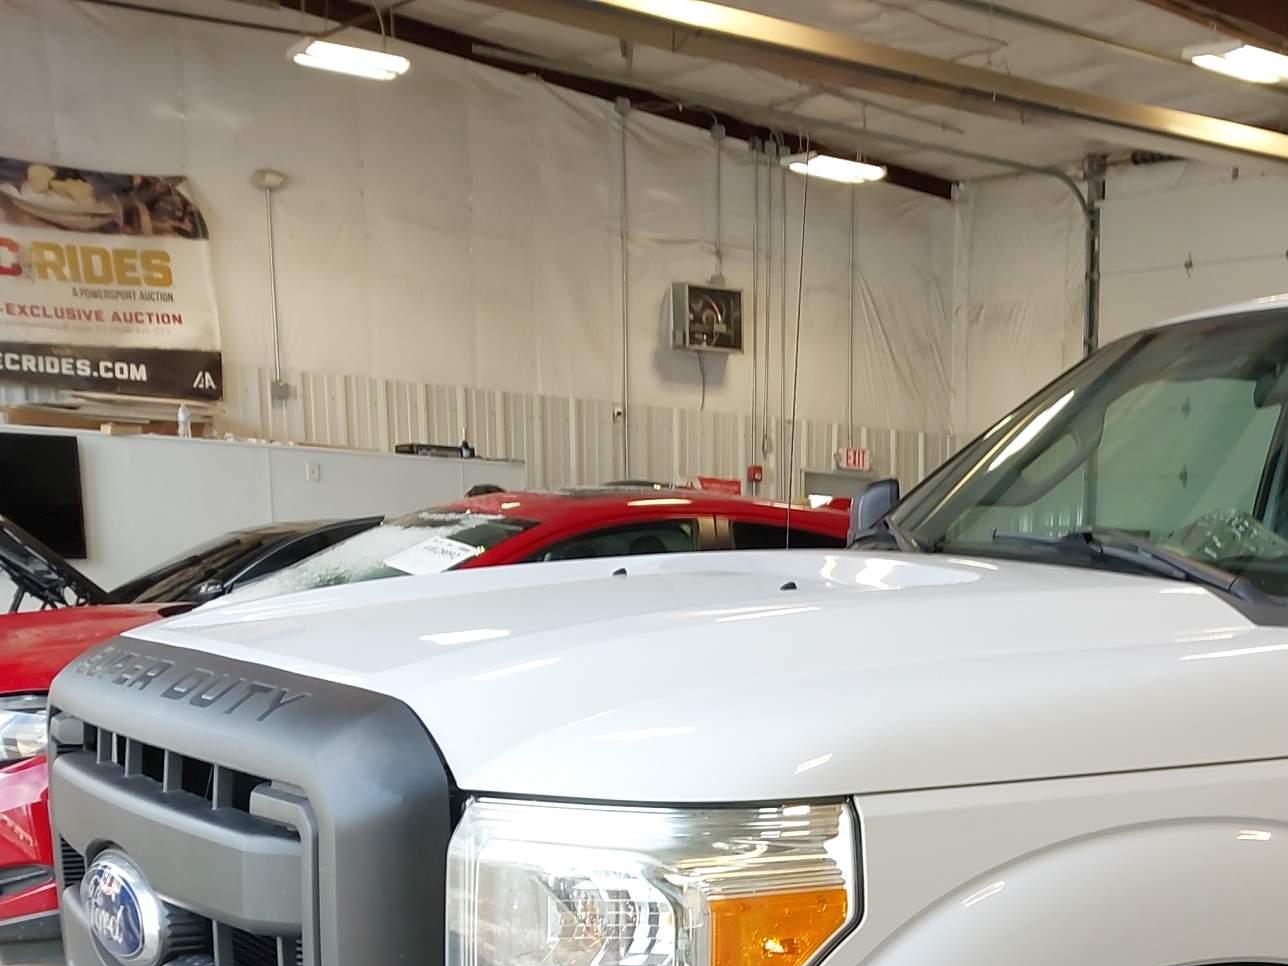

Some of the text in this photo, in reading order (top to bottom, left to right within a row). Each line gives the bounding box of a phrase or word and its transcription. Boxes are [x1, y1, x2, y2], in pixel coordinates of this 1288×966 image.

[139, 290, 175, 303] AUCTION
[111, 310, 184, 325] AUCTION
[845, 448, 865, 468] EXIT
[160, 667, 312, 722] DUTY
